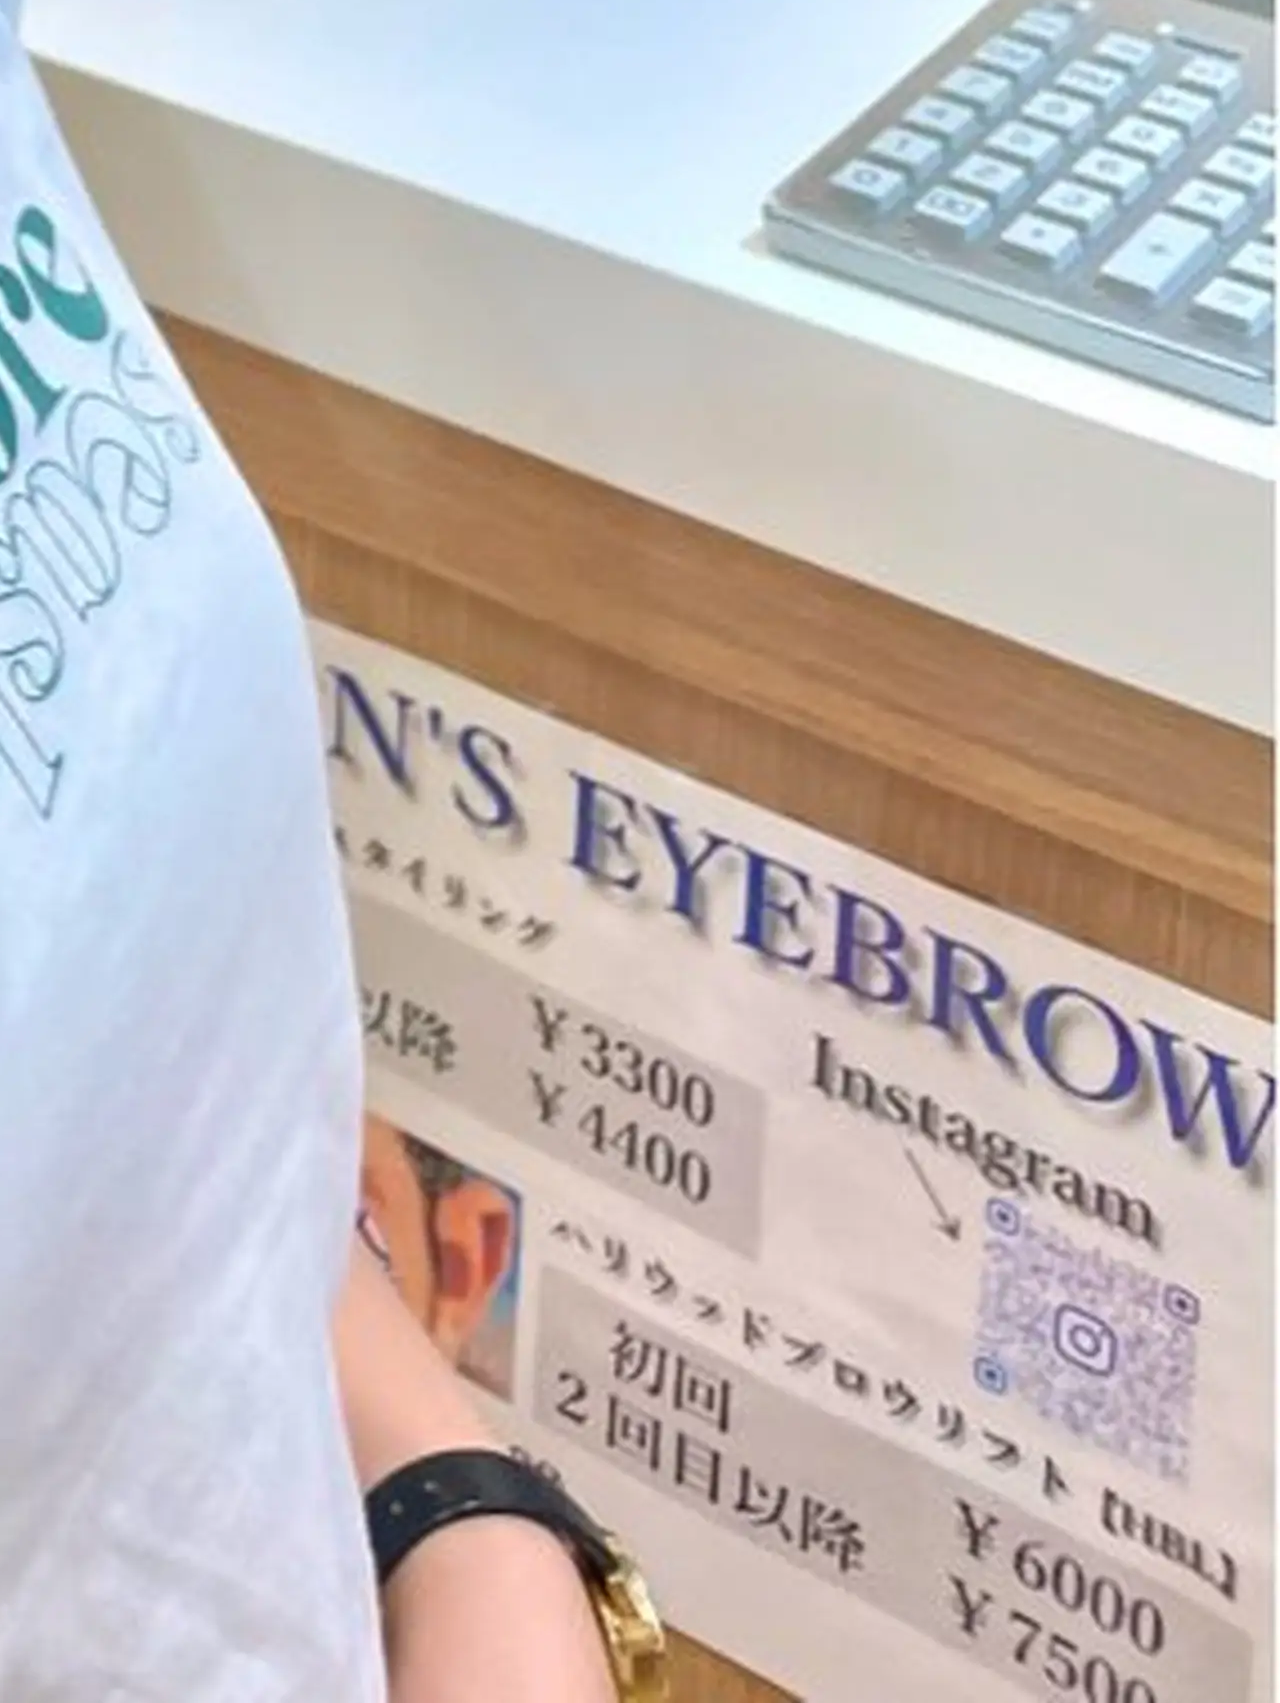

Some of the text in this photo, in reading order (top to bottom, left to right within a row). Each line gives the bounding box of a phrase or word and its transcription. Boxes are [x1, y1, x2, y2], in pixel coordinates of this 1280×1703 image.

[325, 664, 1276, 1173] N'S EYEBROW
[810, 1029, 1162, 1250] Instagram
[554, 1370, 867, 1574] 2回目以降
[608, 1319, 730, 1435] 初回
